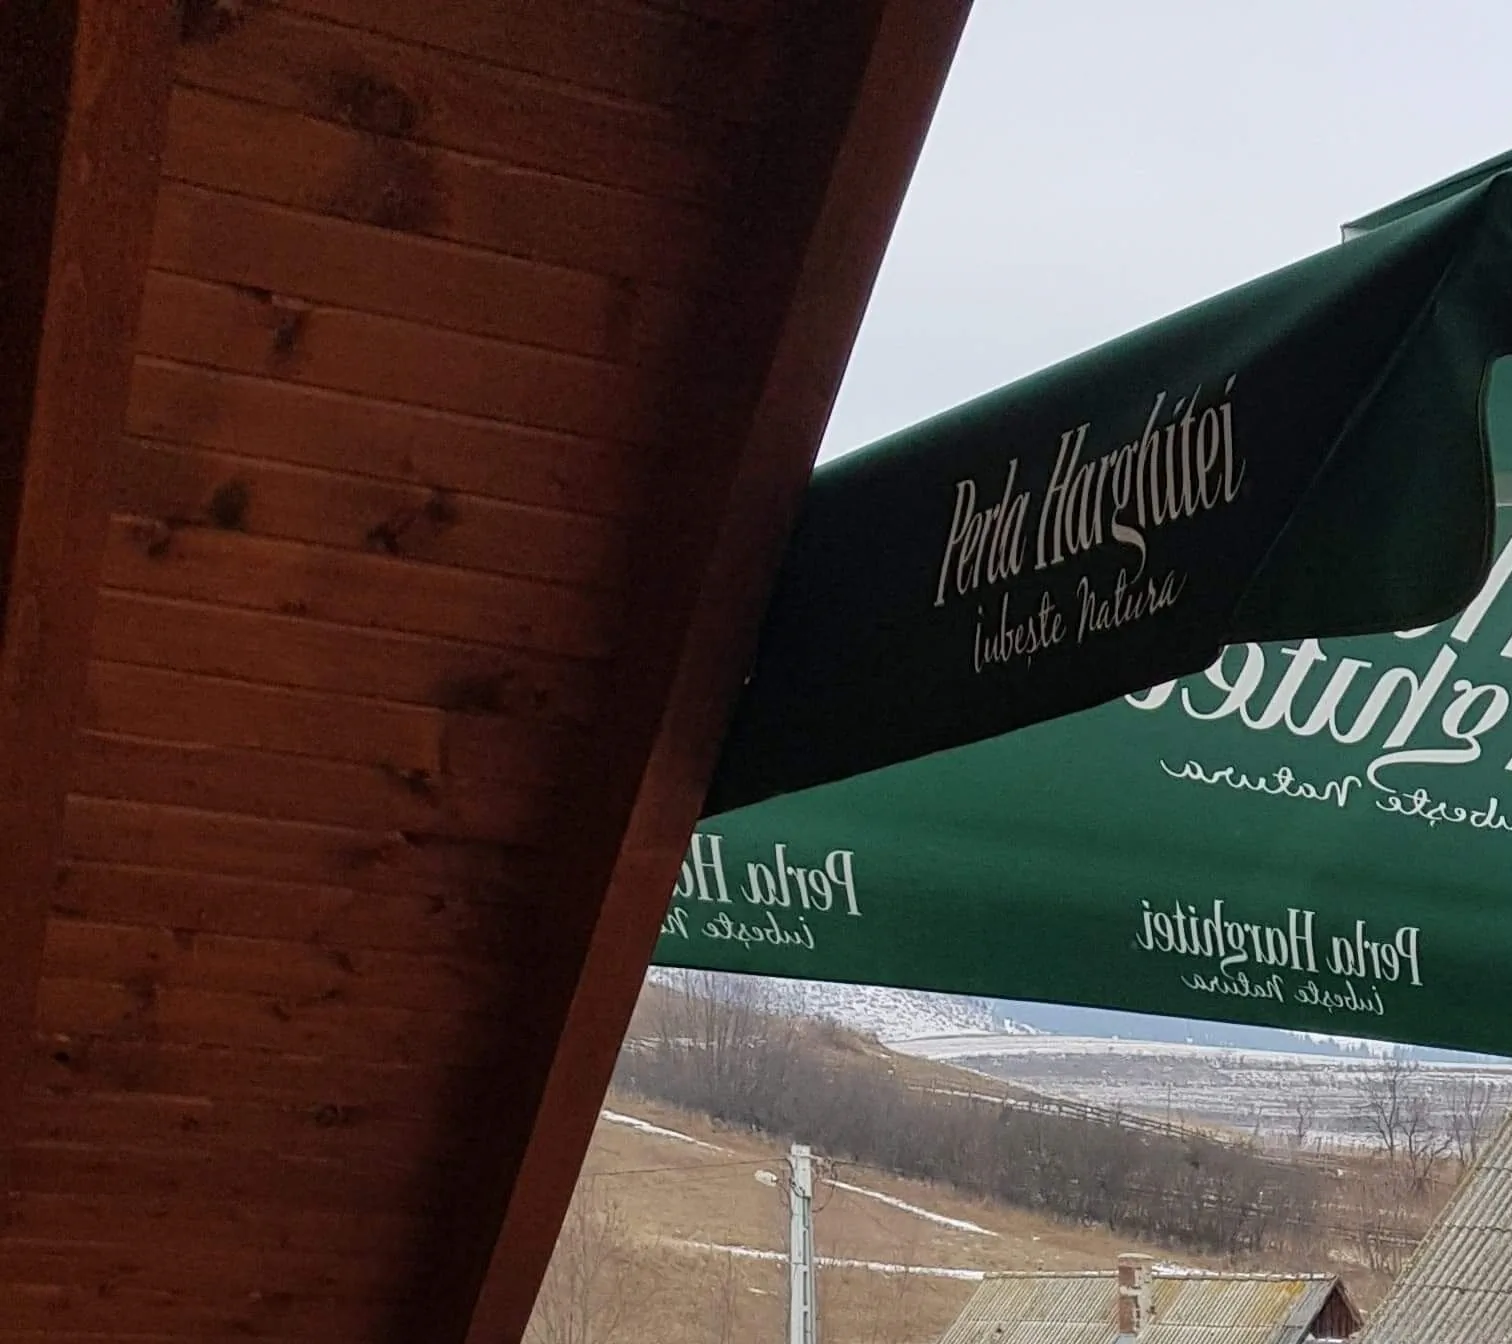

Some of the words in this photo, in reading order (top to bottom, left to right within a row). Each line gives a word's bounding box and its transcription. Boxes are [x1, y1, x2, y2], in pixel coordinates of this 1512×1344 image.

[934, 458, 1031, 608] Perla
[1033, 373, 1247, 583] Harghitei
[1076, 568, 1188, 646] Natura
